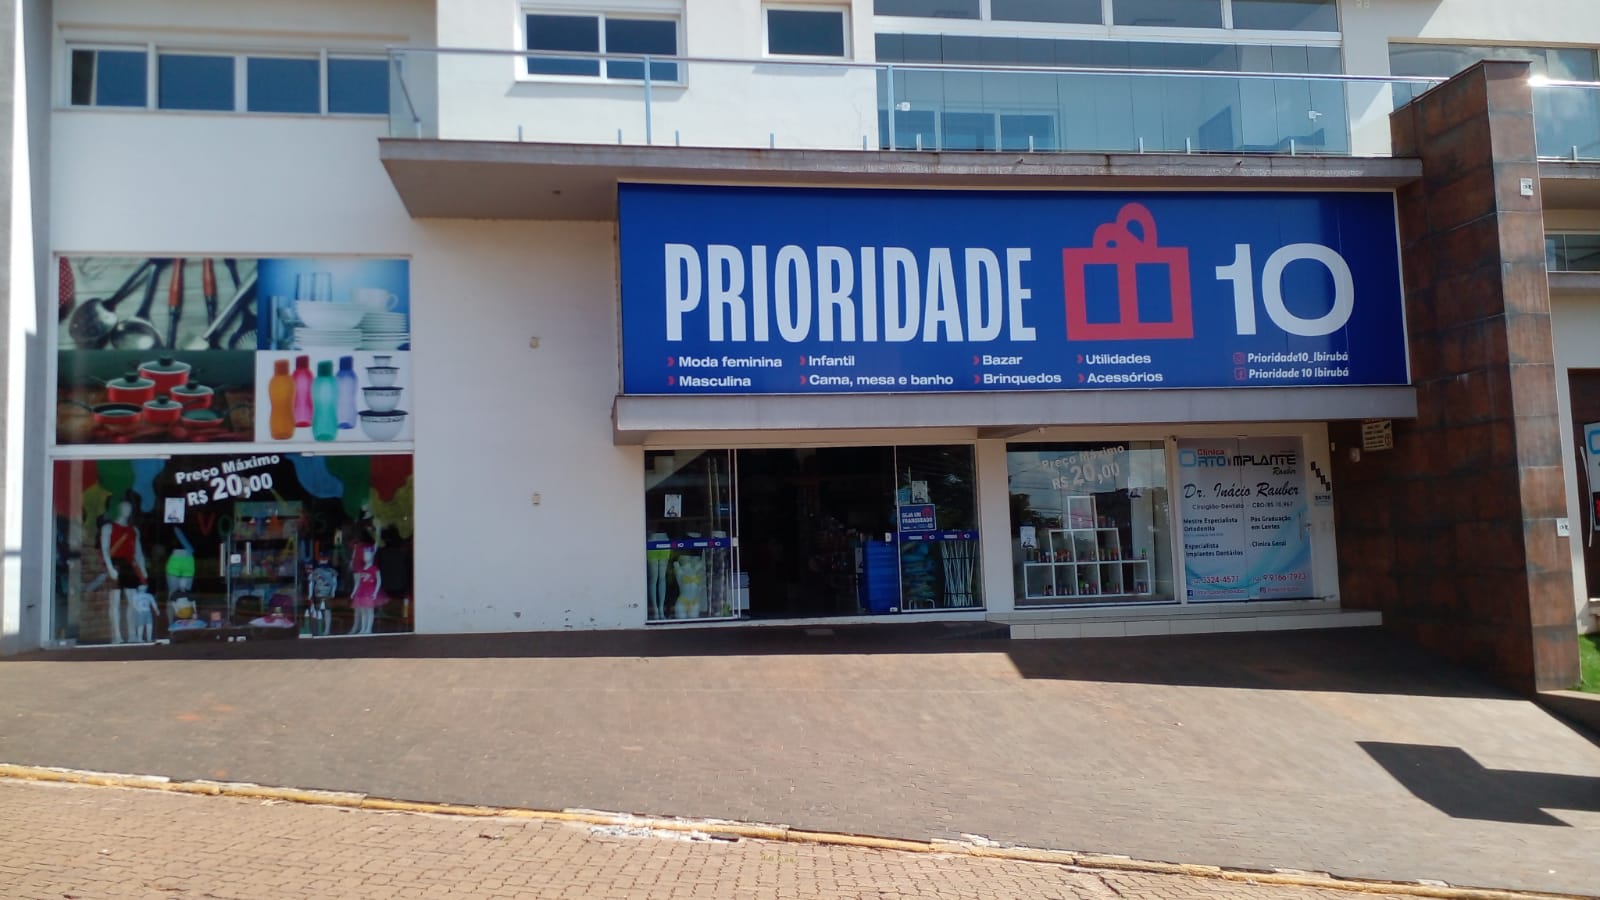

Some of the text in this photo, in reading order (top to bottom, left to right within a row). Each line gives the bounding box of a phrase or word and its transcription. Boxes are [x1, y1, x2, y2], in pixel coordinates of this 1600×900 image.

[664, 243, 1037, 343] PRIORIDADE
[1215, 243, 1355, 337] 10
[678, 356, 783, 367] Moda feminina
[808, 355, 855, 366] Infantil
[982, 355, 1023, 366] Bazar
[1085, 353, 1152, 365] Utilidades
[1247, 351, 1349, 363] Prioridade10_Ibirubá
[983, 372, 1062, 386] Brinquedos
[1087, 371, 1164, 384] Acessórios
[1248, 367, 1349, 379] Prioridade 10 Ibirubá
[679, 375, 752, 387] Masculina
[809, 374, 954, 387] Cama, mesa e banho
[1040, 445, 1125, 471] Preço Máximo
[175, 455, 280, 485] Preço Máximo
[1051, 462, 1120, 490] R$ 20,00
[186, 473, 274, 506] R$ 20,00
[1183, 481, 1300, 499] Dr. Inácio Rauber
[1204, 516, 1238, 524] Especialista
